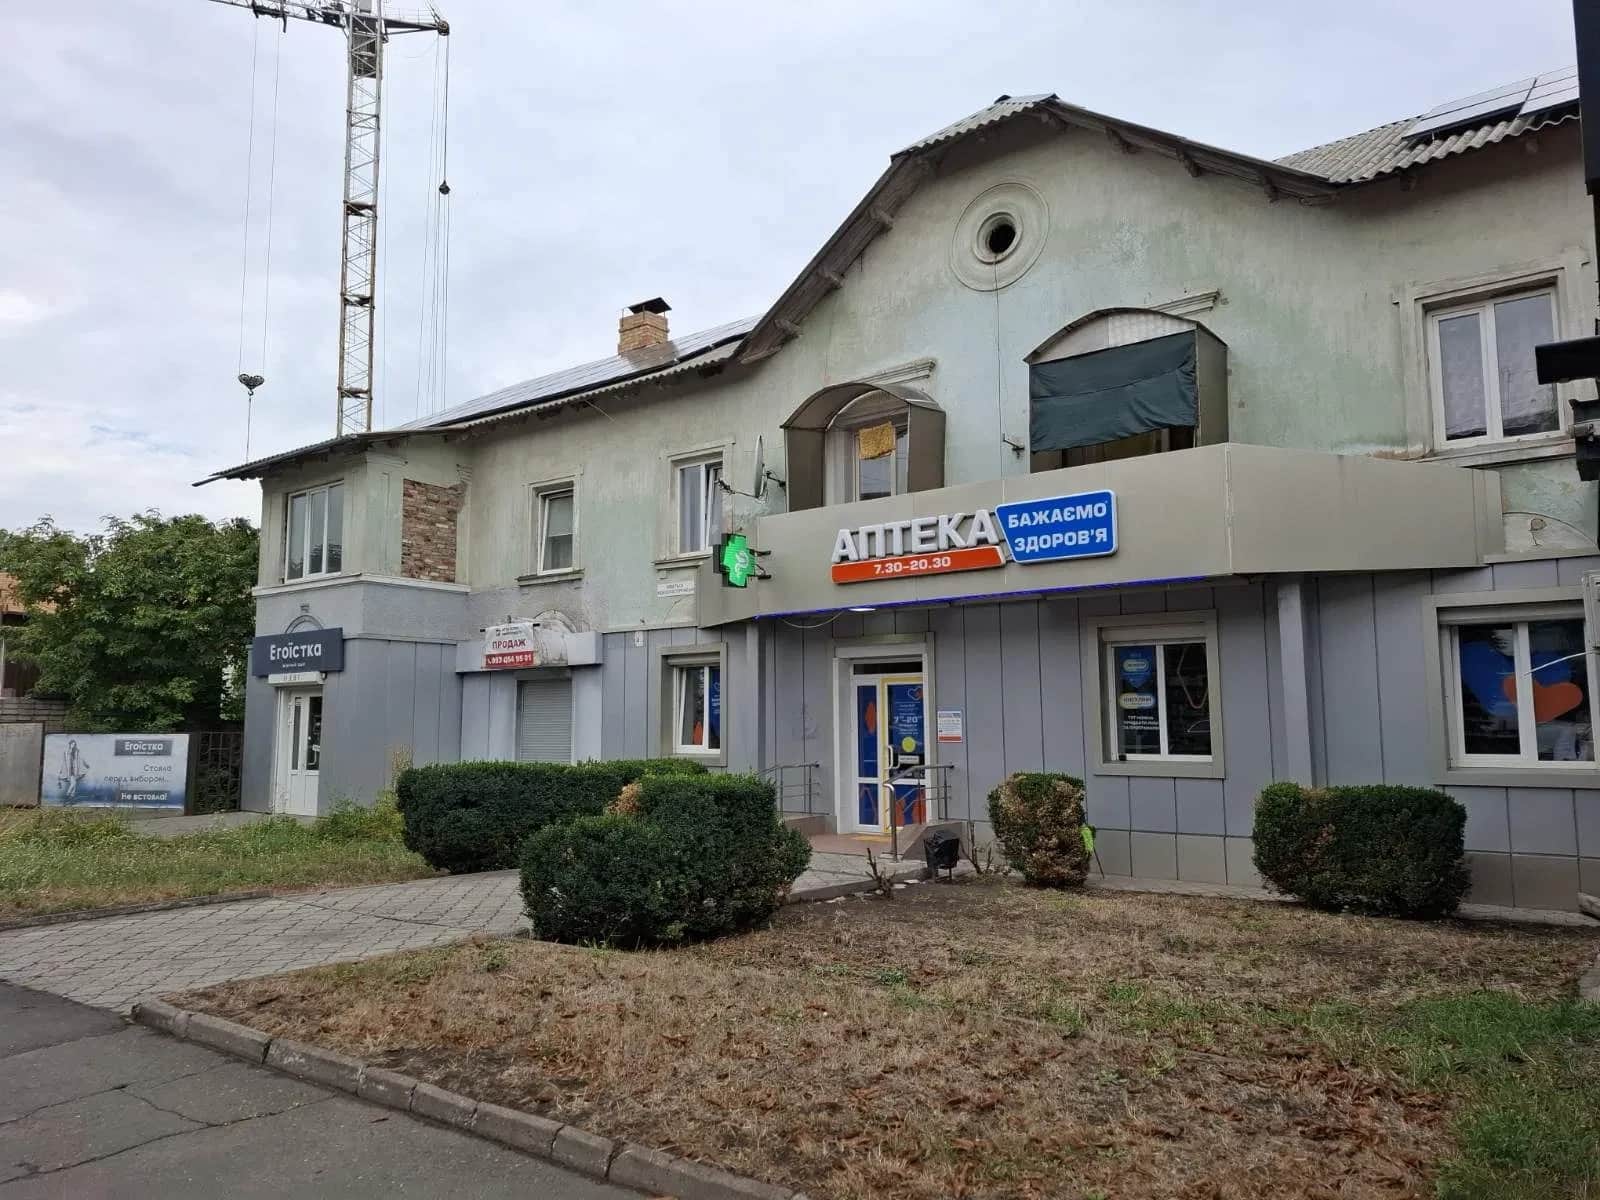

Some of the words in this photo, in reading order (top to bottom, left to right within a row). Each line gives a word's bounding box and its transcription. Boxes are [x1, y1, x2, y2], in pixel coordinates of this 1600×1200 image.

[1008, 502, 1107, 529] БАЖАЄМО
[833, 509, 1001, 564] АПТЕКА
[1014, 528, 1107, 554] ЗДОРОВ'Я
[873, 556, 952, 576] 7.30-20.30
[270, 641, 322, 661] Егоїстка
[492, 638, 527, 650] ПРОДАЖ
[124, 741, 164, 751] Егоїстка
[121, 792, 132, 800] Не
